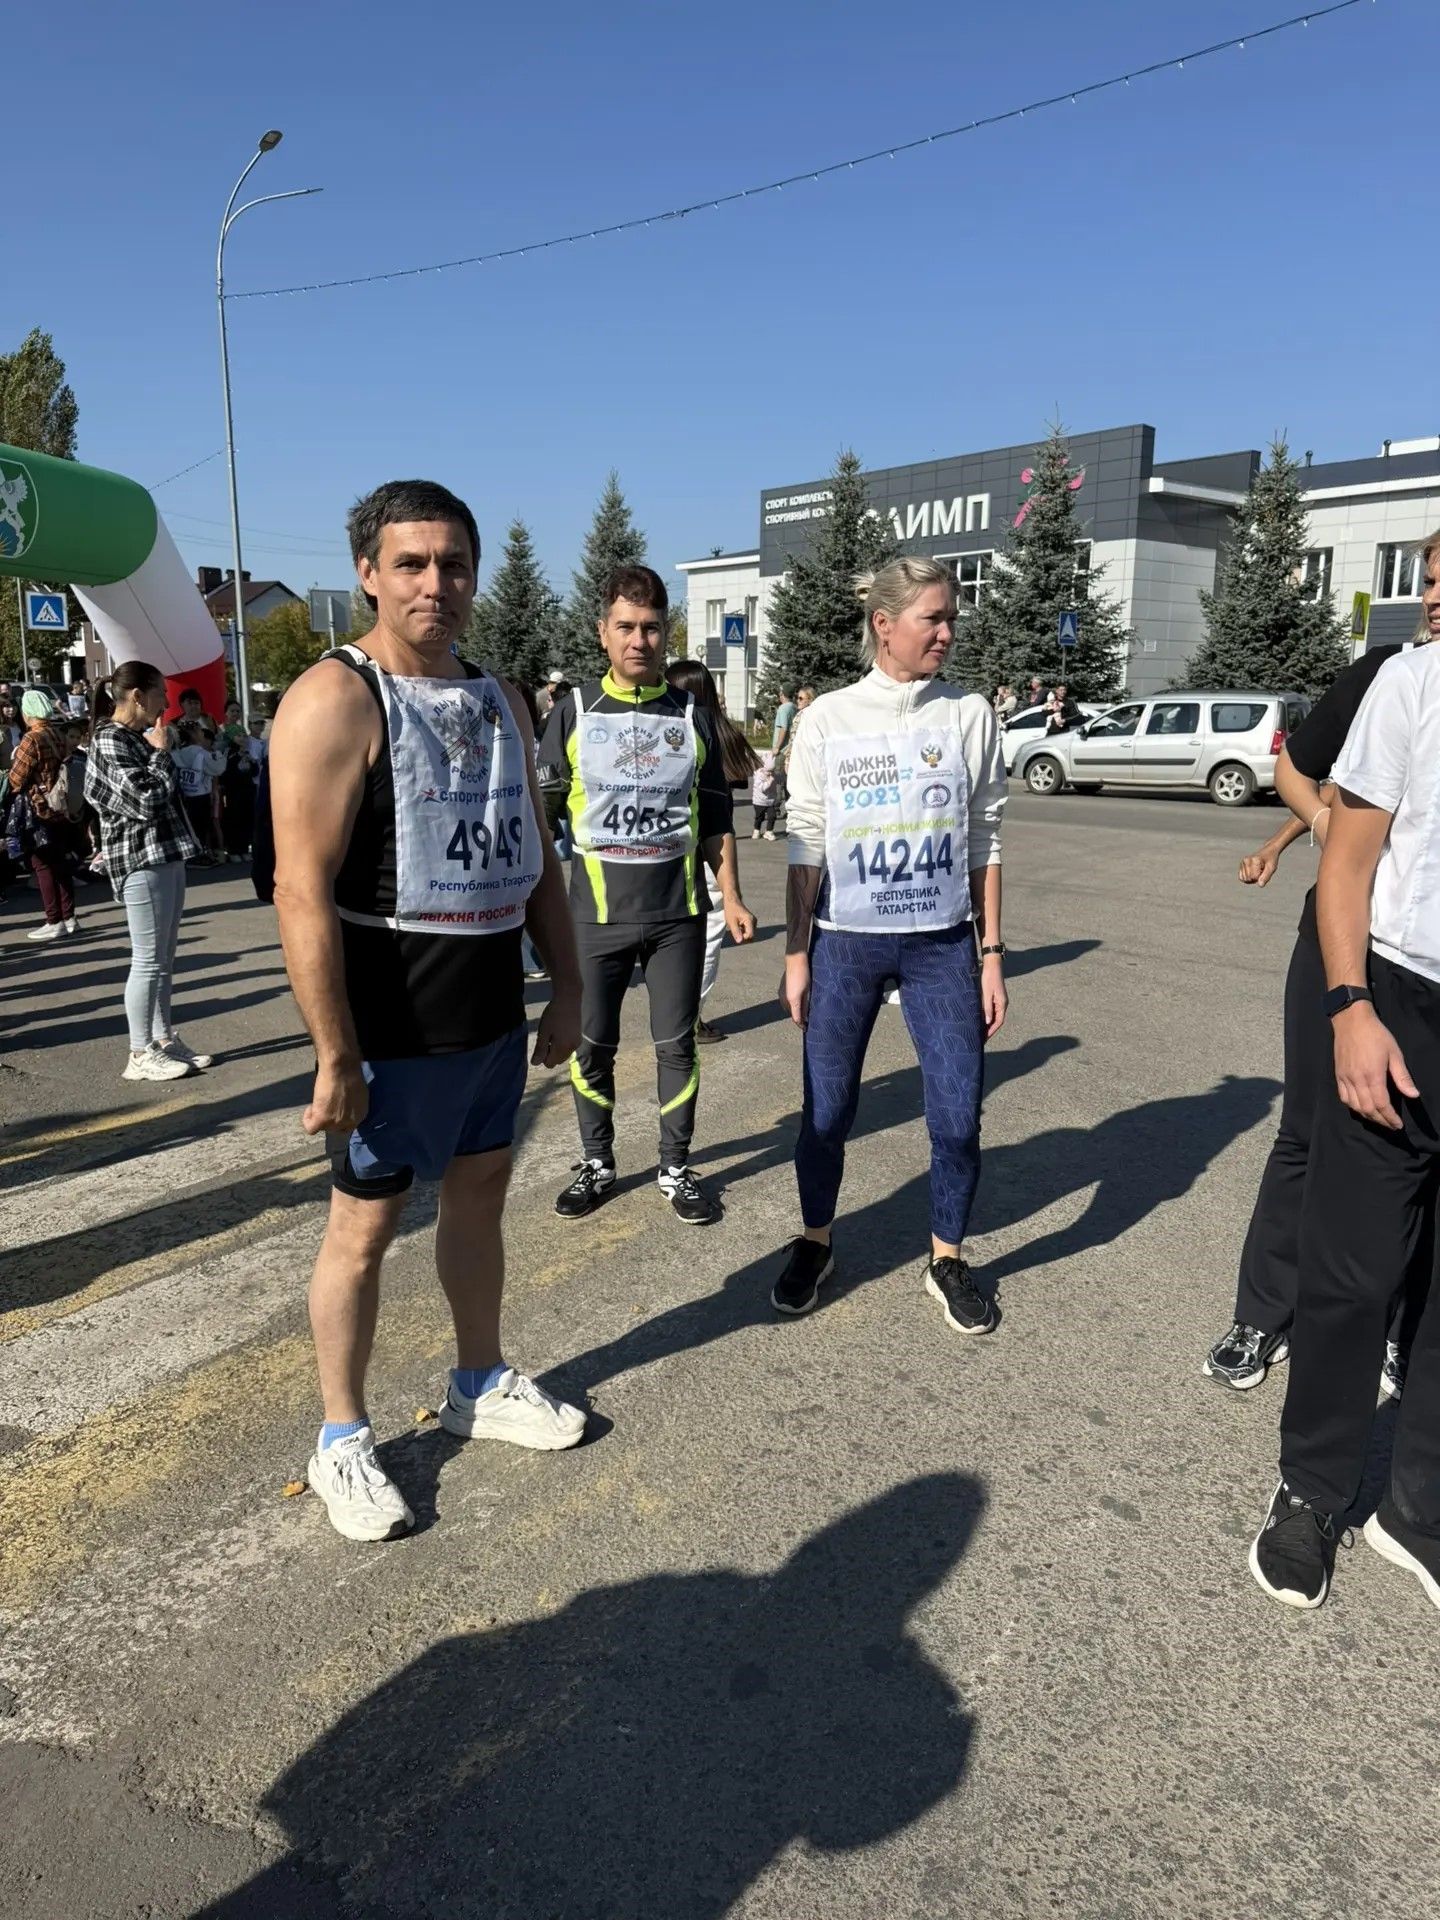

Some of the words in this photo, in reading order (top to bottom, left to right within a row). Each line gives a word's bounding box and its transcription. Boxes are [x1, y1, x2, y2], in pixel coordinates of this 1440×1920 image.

[765, 497, 787, 510] СПОРТ
[620, 768, 655, 780] РОССИИ
[838, 754, 897, 777] ЛЫЖНЯ
[840, 768, 899, 791] РОССИИ
[844, 785, 901, 810] 2023
[602, 803, 671, 837] 4956
[446, 815, 523, 871] 4949
[848, 832, 954, 885] 14244
[429, 879, 500, 894] Республика
[870, 885, 941, 902] РЕСПУБЛИКА
[875, 900, 937, 916] ТАТАРСТАН
